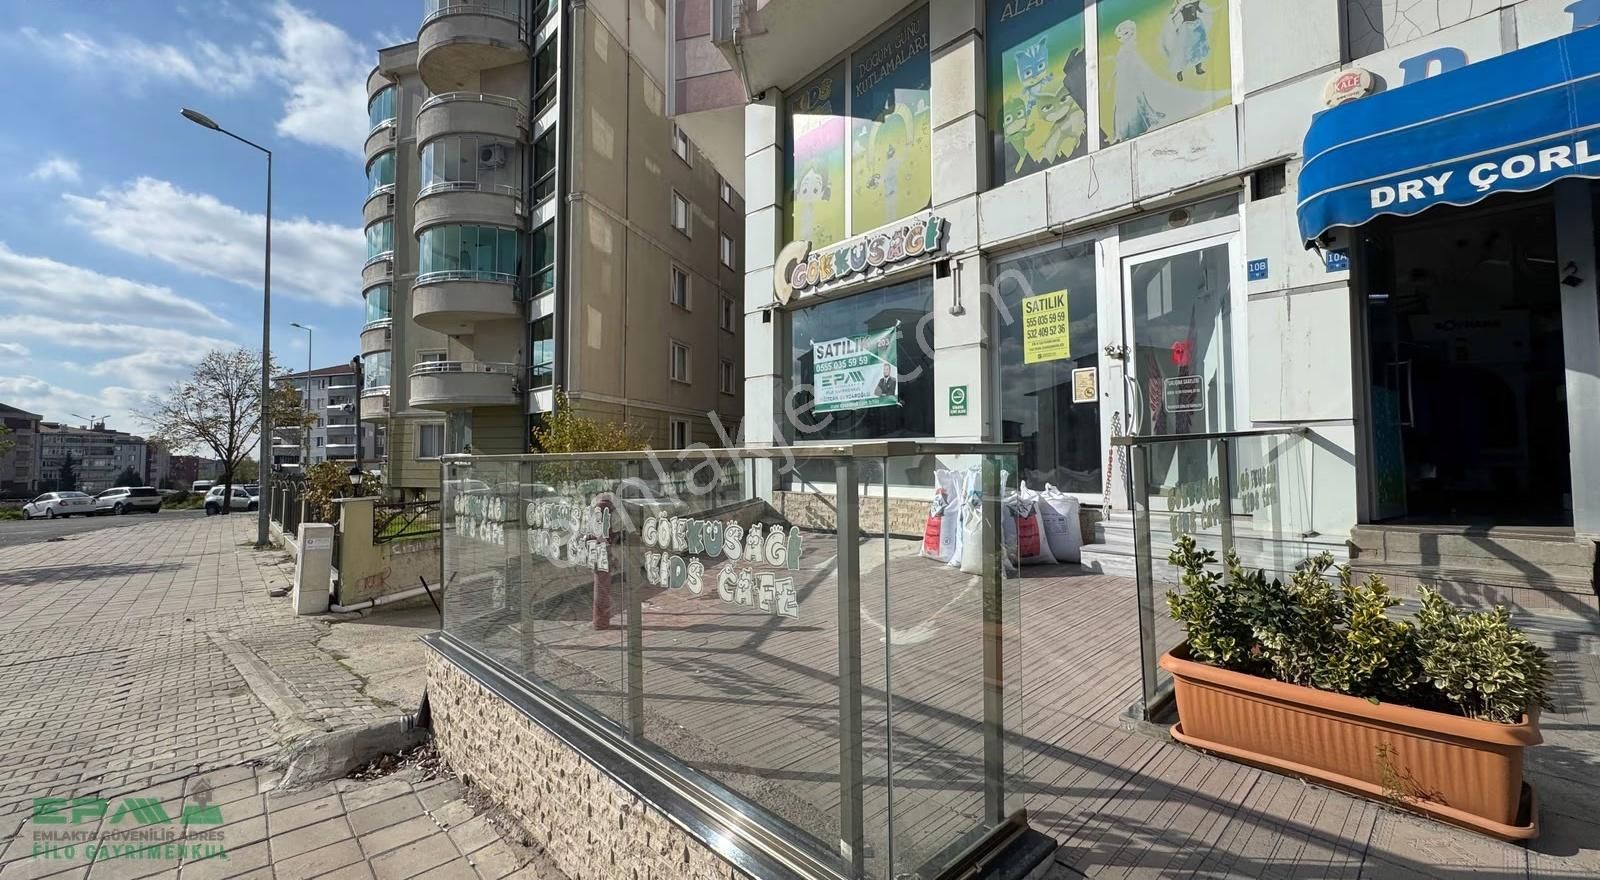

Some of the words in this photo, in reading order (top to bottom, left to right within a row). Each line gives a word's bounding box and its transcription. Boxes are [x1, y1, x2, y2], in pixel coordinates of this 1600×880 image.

[856, 33, 928, 97] KUTLAMALARI
[1370, 171, 1454, 208] DRY
[1468, 140, 1600, 192] ÇORL
[1249, 261, 1266, 272] 10B
[1026, 295, 1064, 314] SATILIK
[1026, 317, 1037, 328] 555
[1049, 313, 1056, 323] 59
[1057, 312, 1065, 322] 59
[1027, 329, 1037, 339] 532
[815, 363, 832, 372] 0555
[848, 358, 857, 367] 59
[859, 356, 868, 365] 59
[644, 551, 705, 595] KIDS
[717, 564, 799, 619] CAFE
